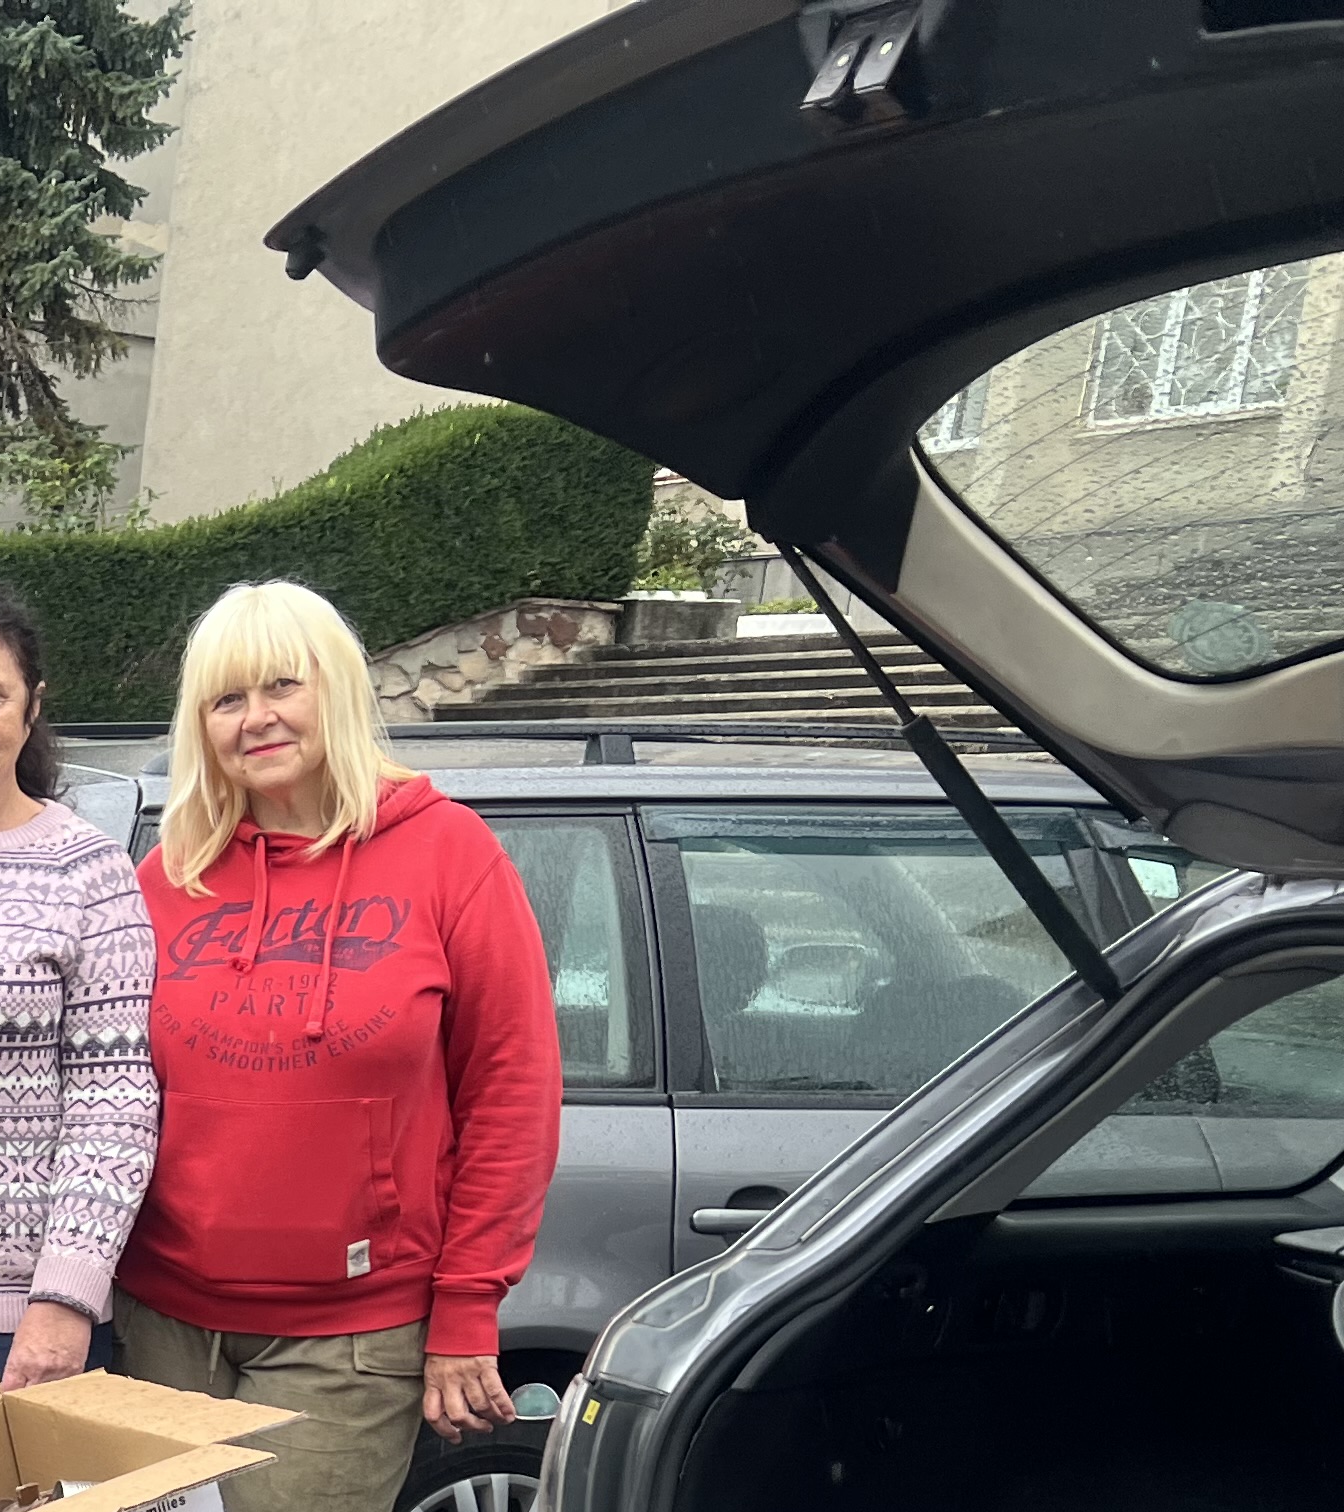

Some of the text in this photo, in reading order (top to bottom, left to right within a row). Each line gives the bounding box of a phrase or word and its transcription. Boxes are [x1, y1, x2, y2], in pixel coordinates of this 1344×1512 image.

[154, 1004, 396, 1073] FOR A SMOOTHER ENGINE
